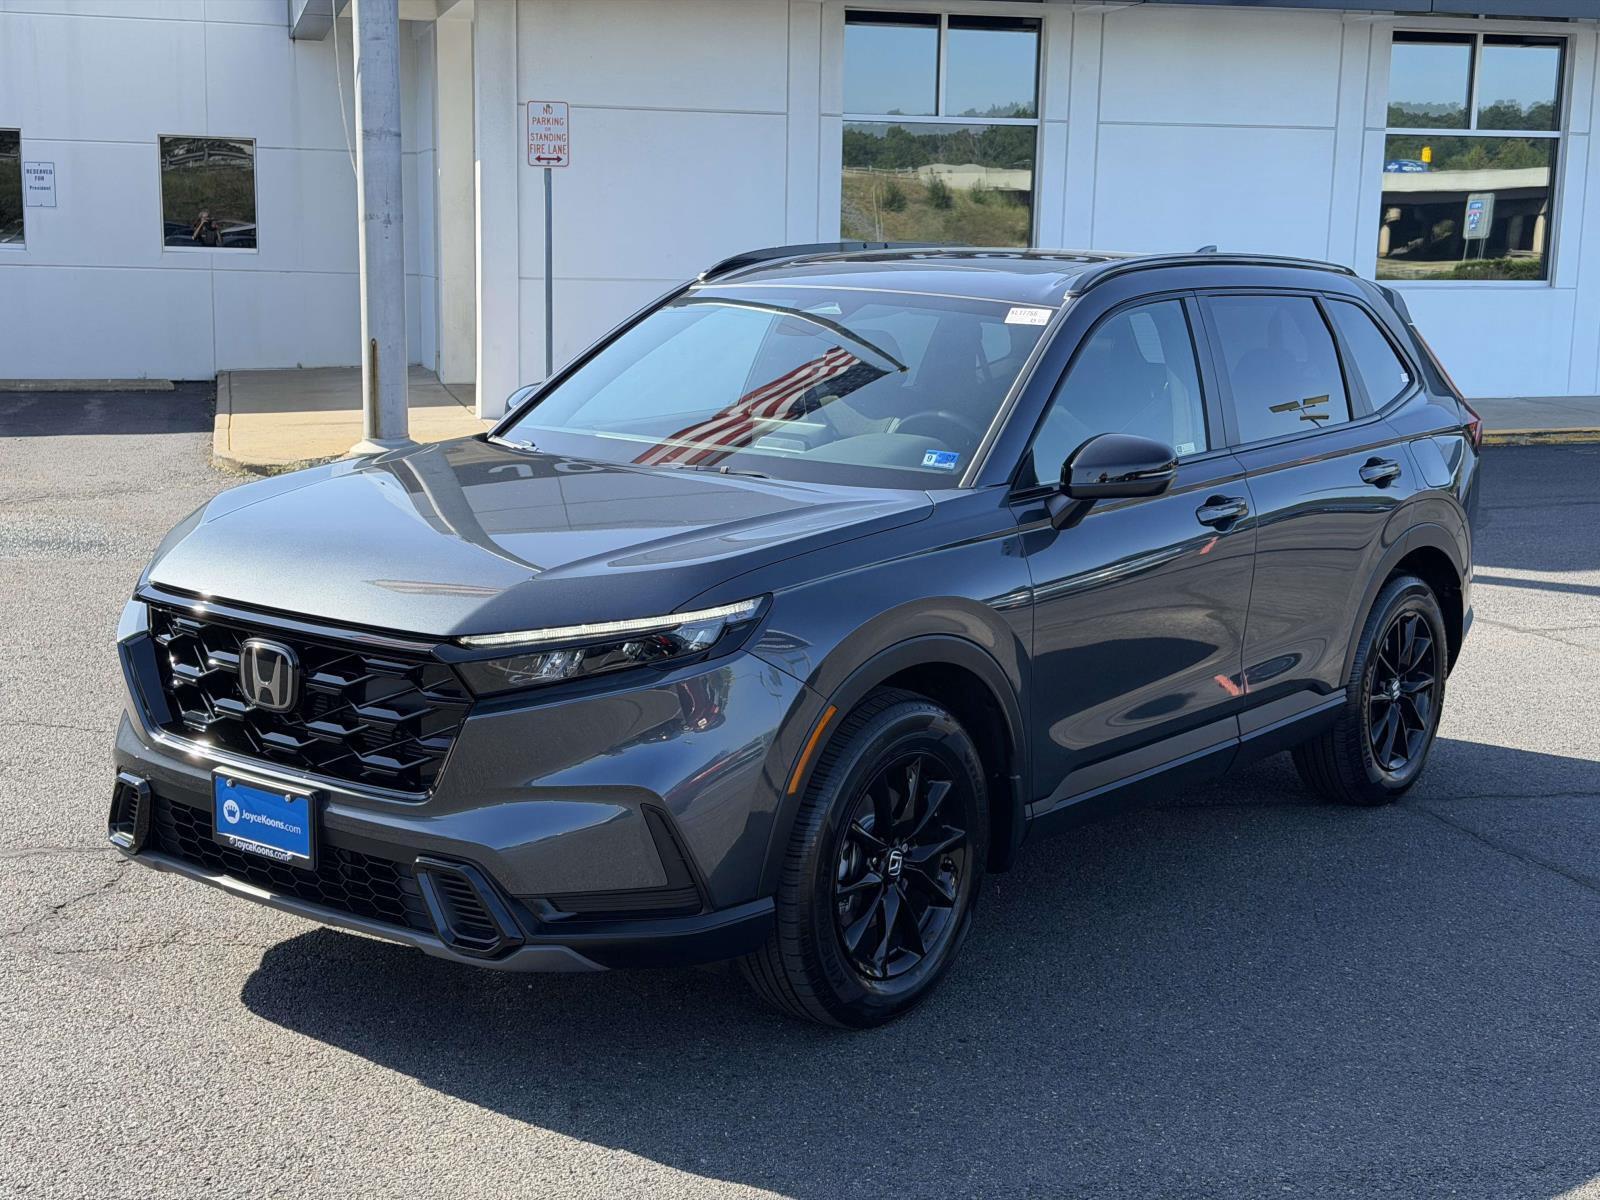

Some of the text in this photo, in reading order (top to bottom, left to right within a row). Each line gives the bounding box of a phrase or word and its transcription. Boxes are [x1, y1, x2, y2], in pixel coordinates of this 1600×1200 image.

[543, 106, 553, 115] NO
[532, 117, 564, 126] PARKING
[530, 133, 567, 142] STANDING
[529, 144, 567, 155] FIRE LANE
[241, 809, 301, 834] JoyceKoons.com
[234, 838, 289, 861] JoyceKoons.com
